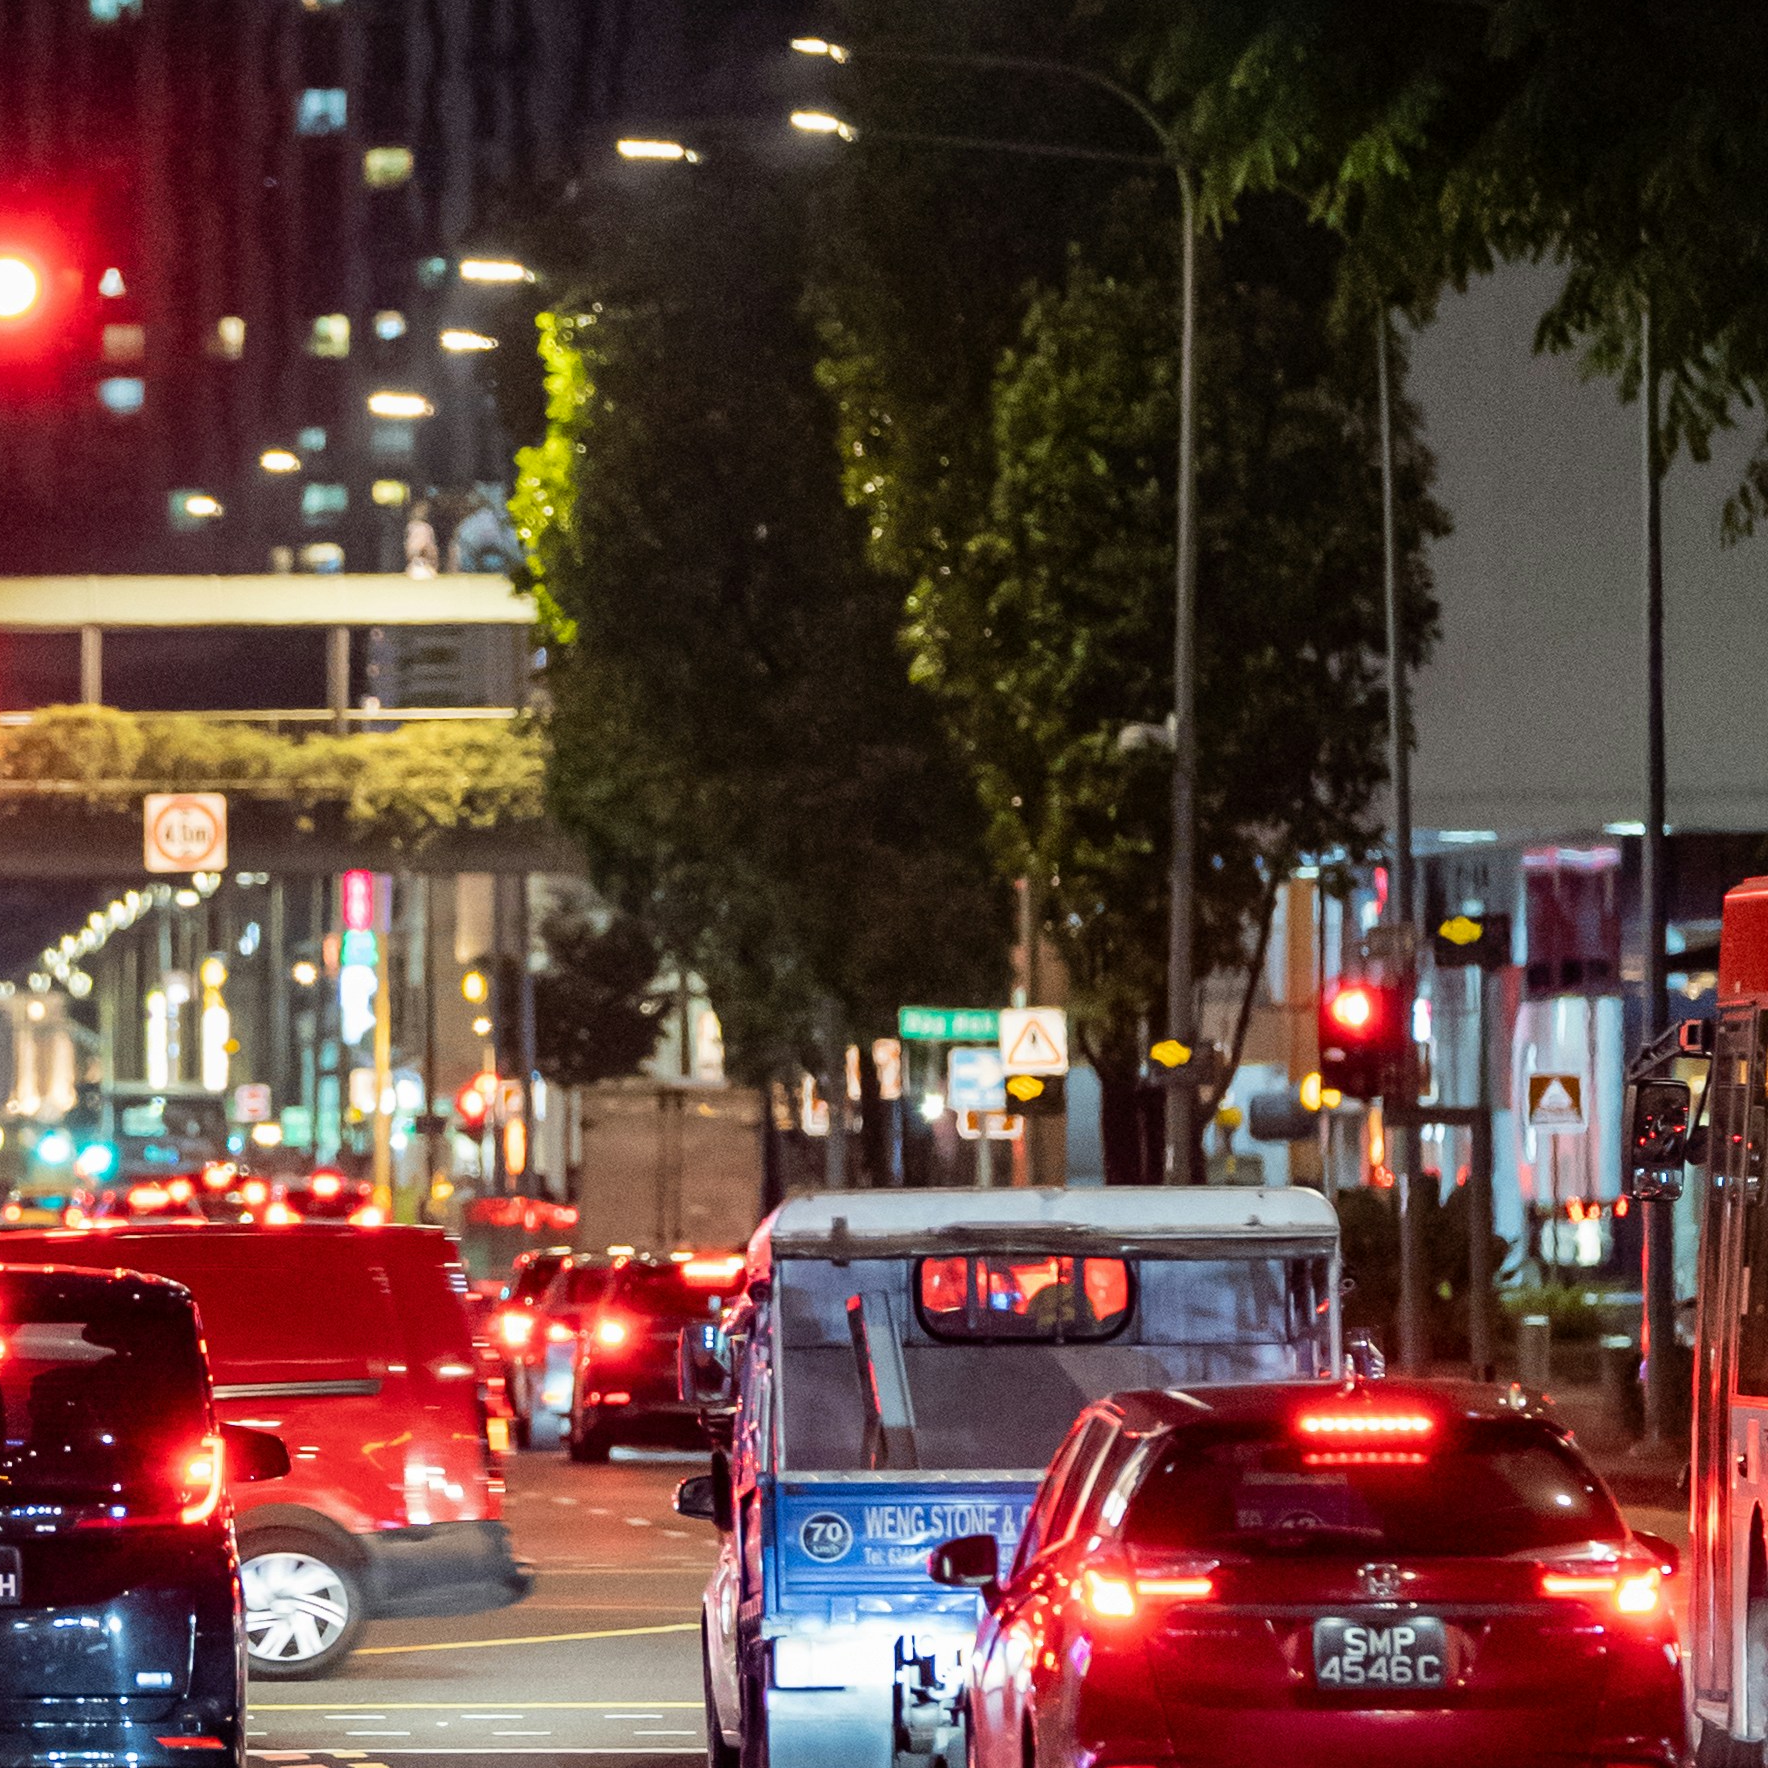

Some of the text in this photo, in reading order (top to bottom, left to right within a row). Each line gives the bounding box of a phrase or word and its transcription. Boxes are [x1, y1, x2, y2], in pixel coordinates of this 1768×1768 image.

[809, 1522, 844, 1542] 70
[864, 1505, 925, 1539] WENG
[1002, 1505, 1017, 1539] &
[1343, 1626, 1416, 1656] SMP
[1320, 1655, 1440, 1684] 4546C
